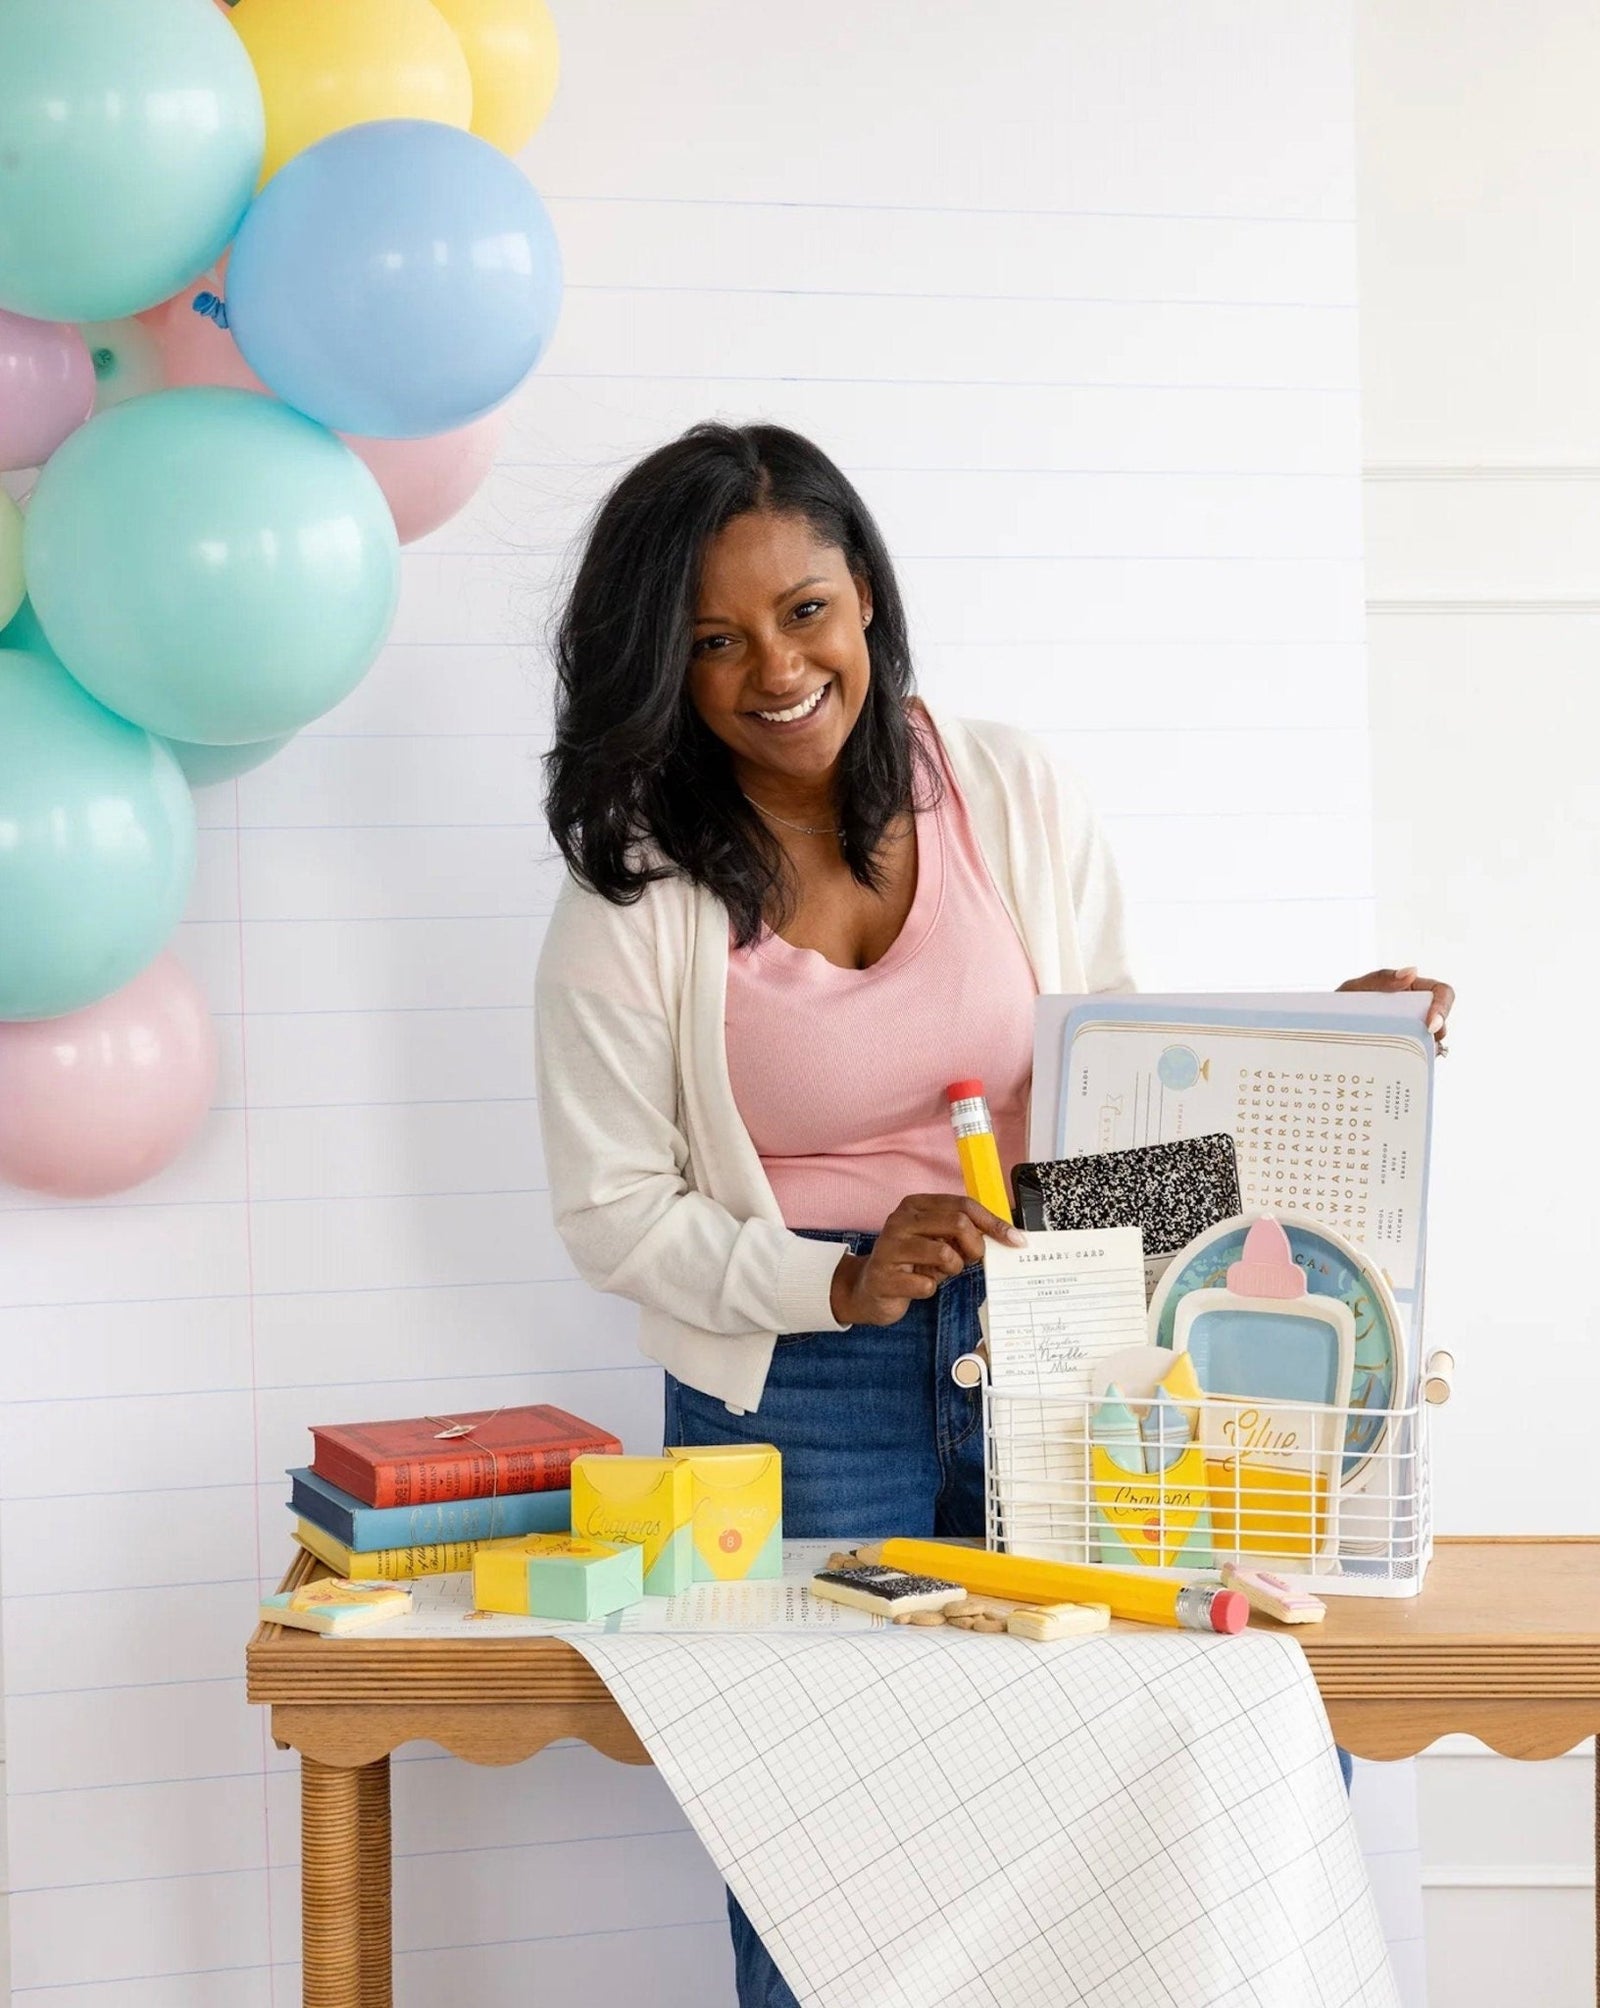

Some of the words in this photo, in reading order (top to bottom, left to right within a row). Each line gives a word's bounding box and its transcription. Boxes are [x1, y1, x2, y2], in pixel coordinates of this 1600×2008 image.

[1019, 1252, 1070, 1263] LIBRARY
[1076, 1250, 1105, 1258] CARD
[1223, 1409, 1299, 1471] Glue
[586, 1504, 662, 1544] Crayons
[726, 1536, 734, 1548] 8
[405, 1546, 413, 1575] Fathe
